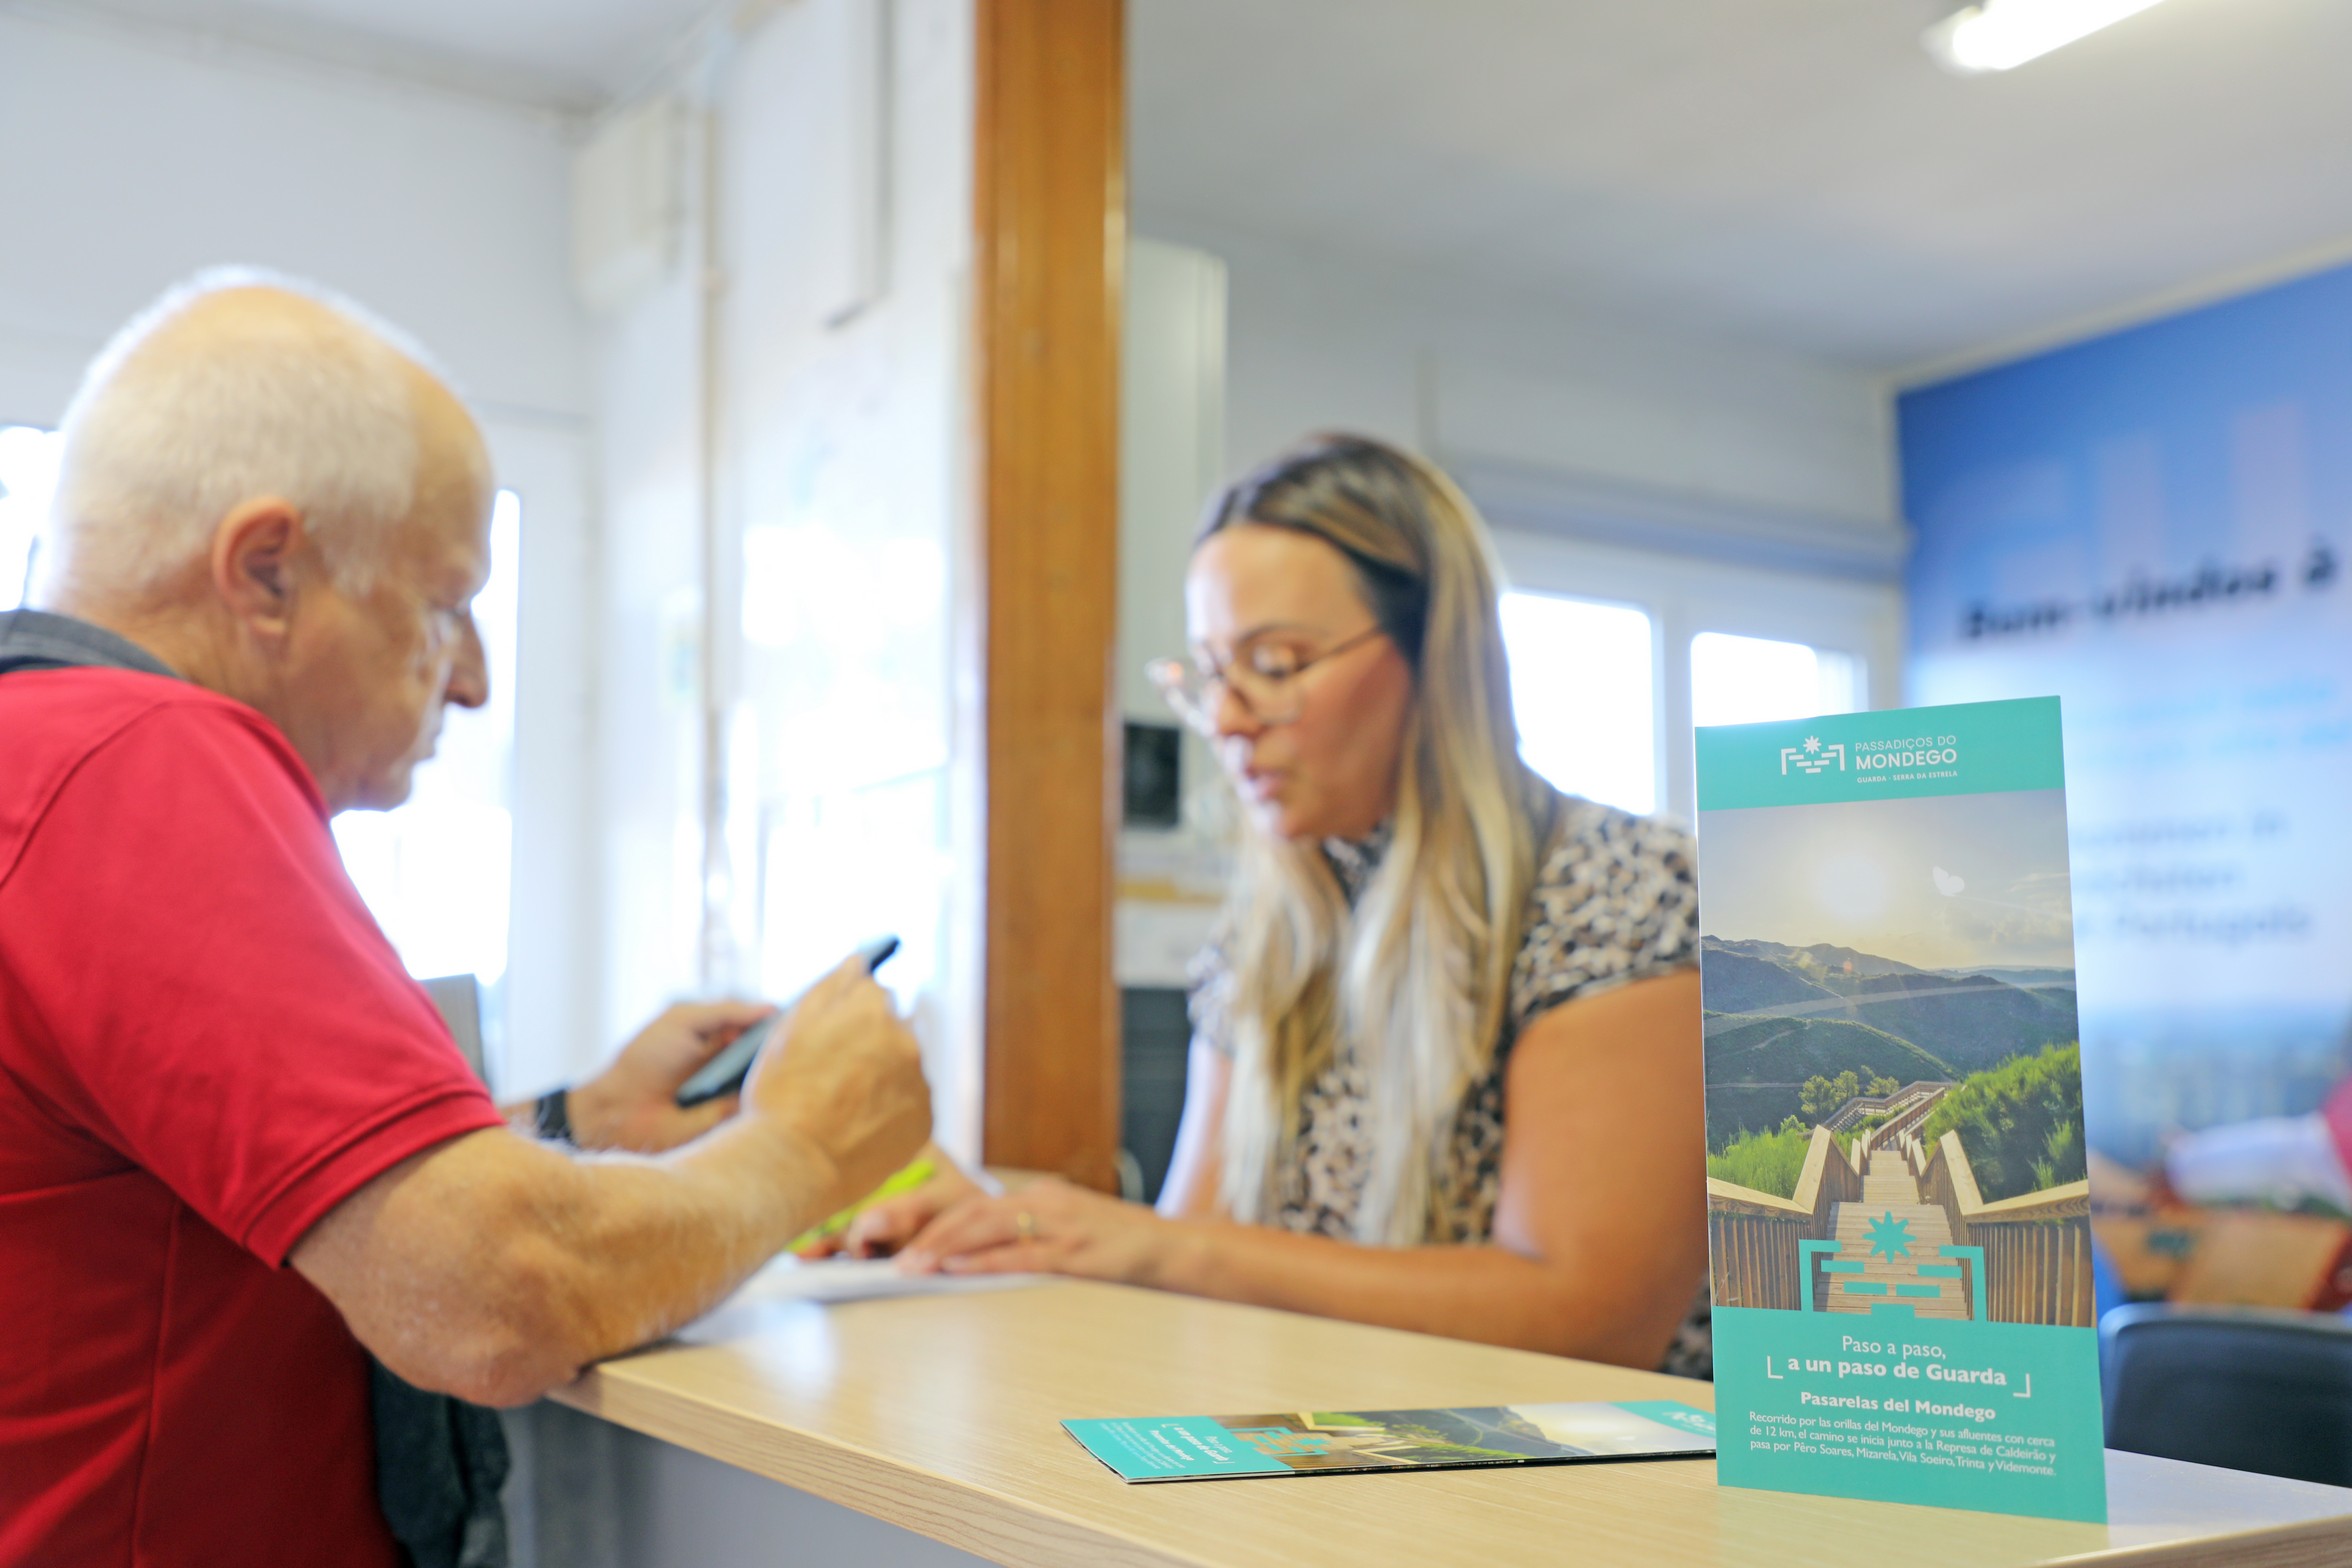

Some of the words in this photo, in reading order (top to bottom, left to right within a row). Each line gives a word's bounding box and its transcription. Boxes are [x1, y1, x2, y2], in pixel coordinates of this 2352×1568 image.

[1855, 736, 1933, 752] PASSADIÇOS
[1937, 735, 1957, 745] DO
[1856, 748, 1957, 770] MONDEGO
[1893, 773, 1915, 781] SERRA
[1929, 770, 1958, 779] ESTRELA
[1842, 1335, 1881, 1353] Paso
[1887, 1343, 1896, 1355] a
[1902, 1344, 1946, 1359] paso,
[1788, 1358, 1800, 1371] a
[1806, 1359, 1832, 1372] un
[1838, 1361, 1887, 1378] paso
[1893, 1362, 1920, 1379] de
[1926, 1364, 2007, 1386] Guarda
[1801, 1392, 1878, 1410] Pasarelas
[1883, 1398, 1910, 1412] del
[1915, 1400, 1996, 1422] Mondego
[1749, 1411, 1797, 1424] Recorrido
[1799, 1418, 1816, 1427] por
[1819, 1417, 1831, 1427] las
[1834, 1419, 1862, 1430] orillas
[1864, 1421, 1879, 1431] del
[1882, 1422, 1928, 1437] Mondego
[1931, 1429, 1937, 1438] y
[1939, 1429, 1955, 1438] sus
[1958, 1428, 2002, 1442] afluentes
[2005, 1435, 2024, 1443] con
[2027, 1437, 2056, 1447] cerca
[1750, 1425, 1762, 1435] de
[1766, 1426, 1776, 1436] 12
[1779, 1427, 1796, 1439] km,
[1798, 1429, 1807, 1439] el
[1810, 1433, 1845, 1443] camino
[1847, 1435, 1858, 1443] se
[1861, 1437, 1885, 1445] inicia
[1888, 1437, 1913, 1448] junto
[1917, 1441, 1922, 1449] a
[1925, 1440, 1933, 1450] la
[1936, 1440, 1977, 1457] Represa
[1980, 1445, 1992, 1455] de
[2049, 1454, 2056, 1464] y
[1750, 1441, 1771, 1450] pasa
[1774, 1443, 1791, 1453] por
[1794, 1442, 1817, 1454] Pêro
[1820, 1444, 1854, 1457] Soares,
[1956, 1456, 1986, 1469] Trinta
[1988, 1462, 1994, 1472] y
